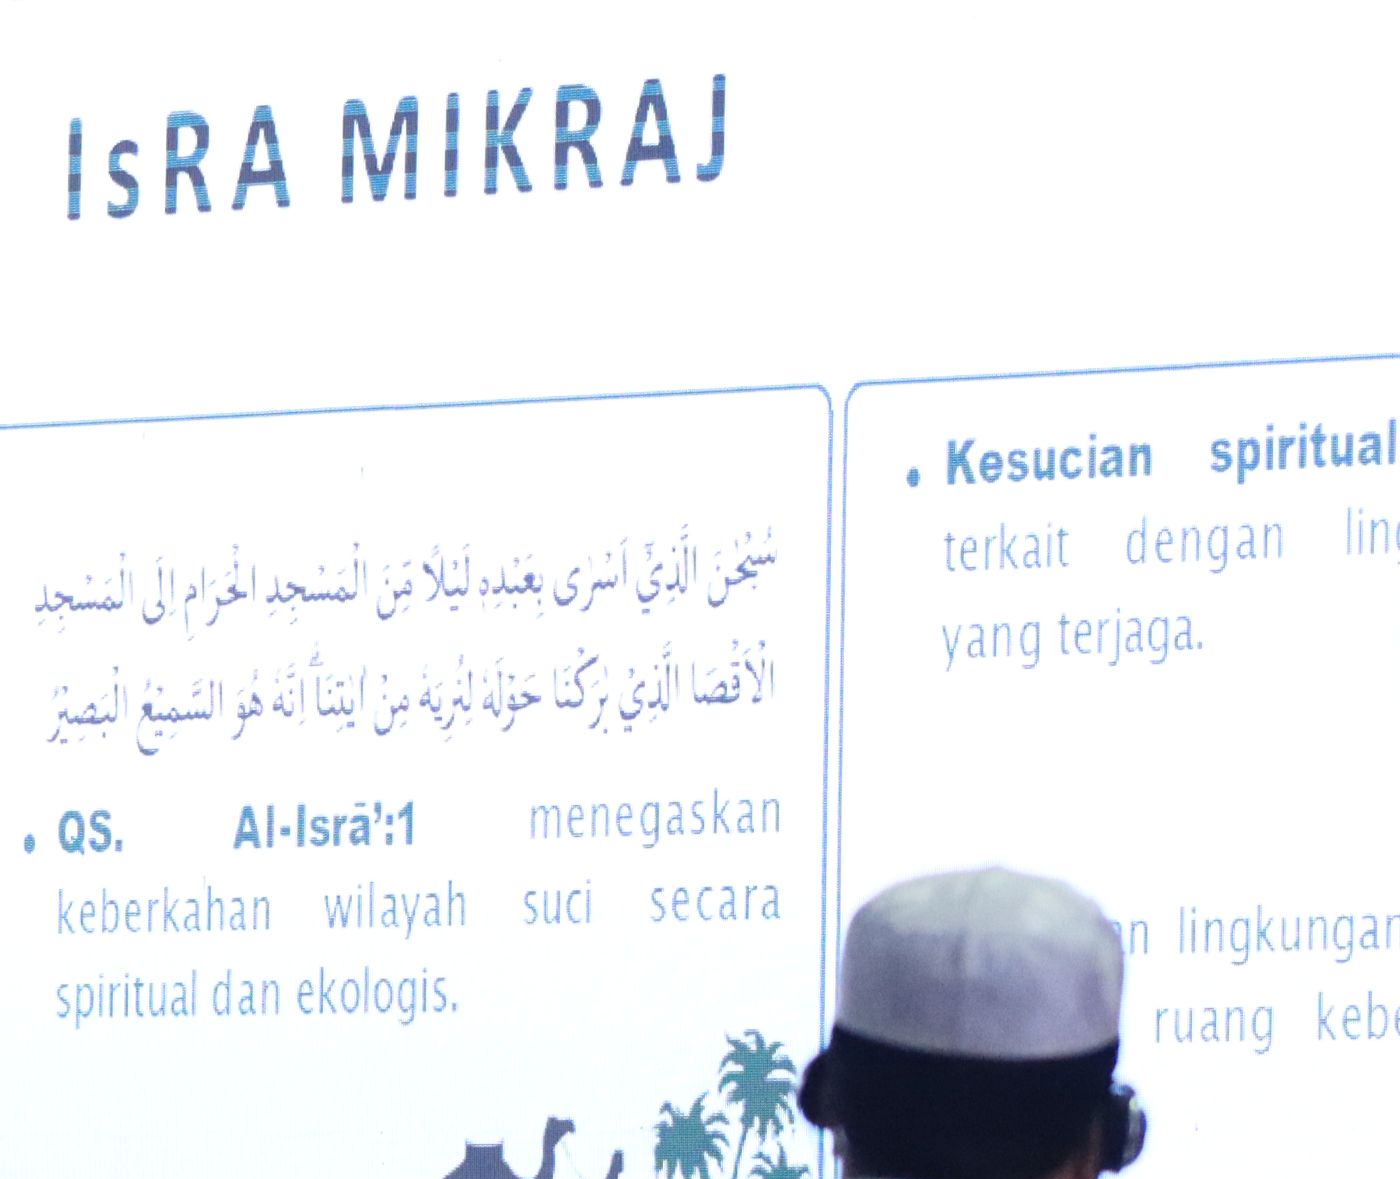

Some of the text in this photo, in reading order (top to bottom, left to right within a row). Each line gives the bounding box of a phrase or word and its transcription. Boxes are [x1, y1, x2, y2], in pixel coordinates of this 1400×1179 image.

[67, 73, 727, 221] IsRA MIKRAJ
[946, 417, 1398, 485] Kesucian spiritual
[944, 506, 1400, 575] terkait dengan lin
[942, 608, 1203, 673] yang terjaga.
[57, 808, 124, 856] QS.
[530, 788, 781, 849] menegaskan
[58, 879, 781, 940] keberkahan wilayah suci secara
[1179, 904, 1400, 966] lingkungan
[56, 966, 459, 1031] spiritual dan ekologis.
[1155, 1005, 1274, 1055] ruang
